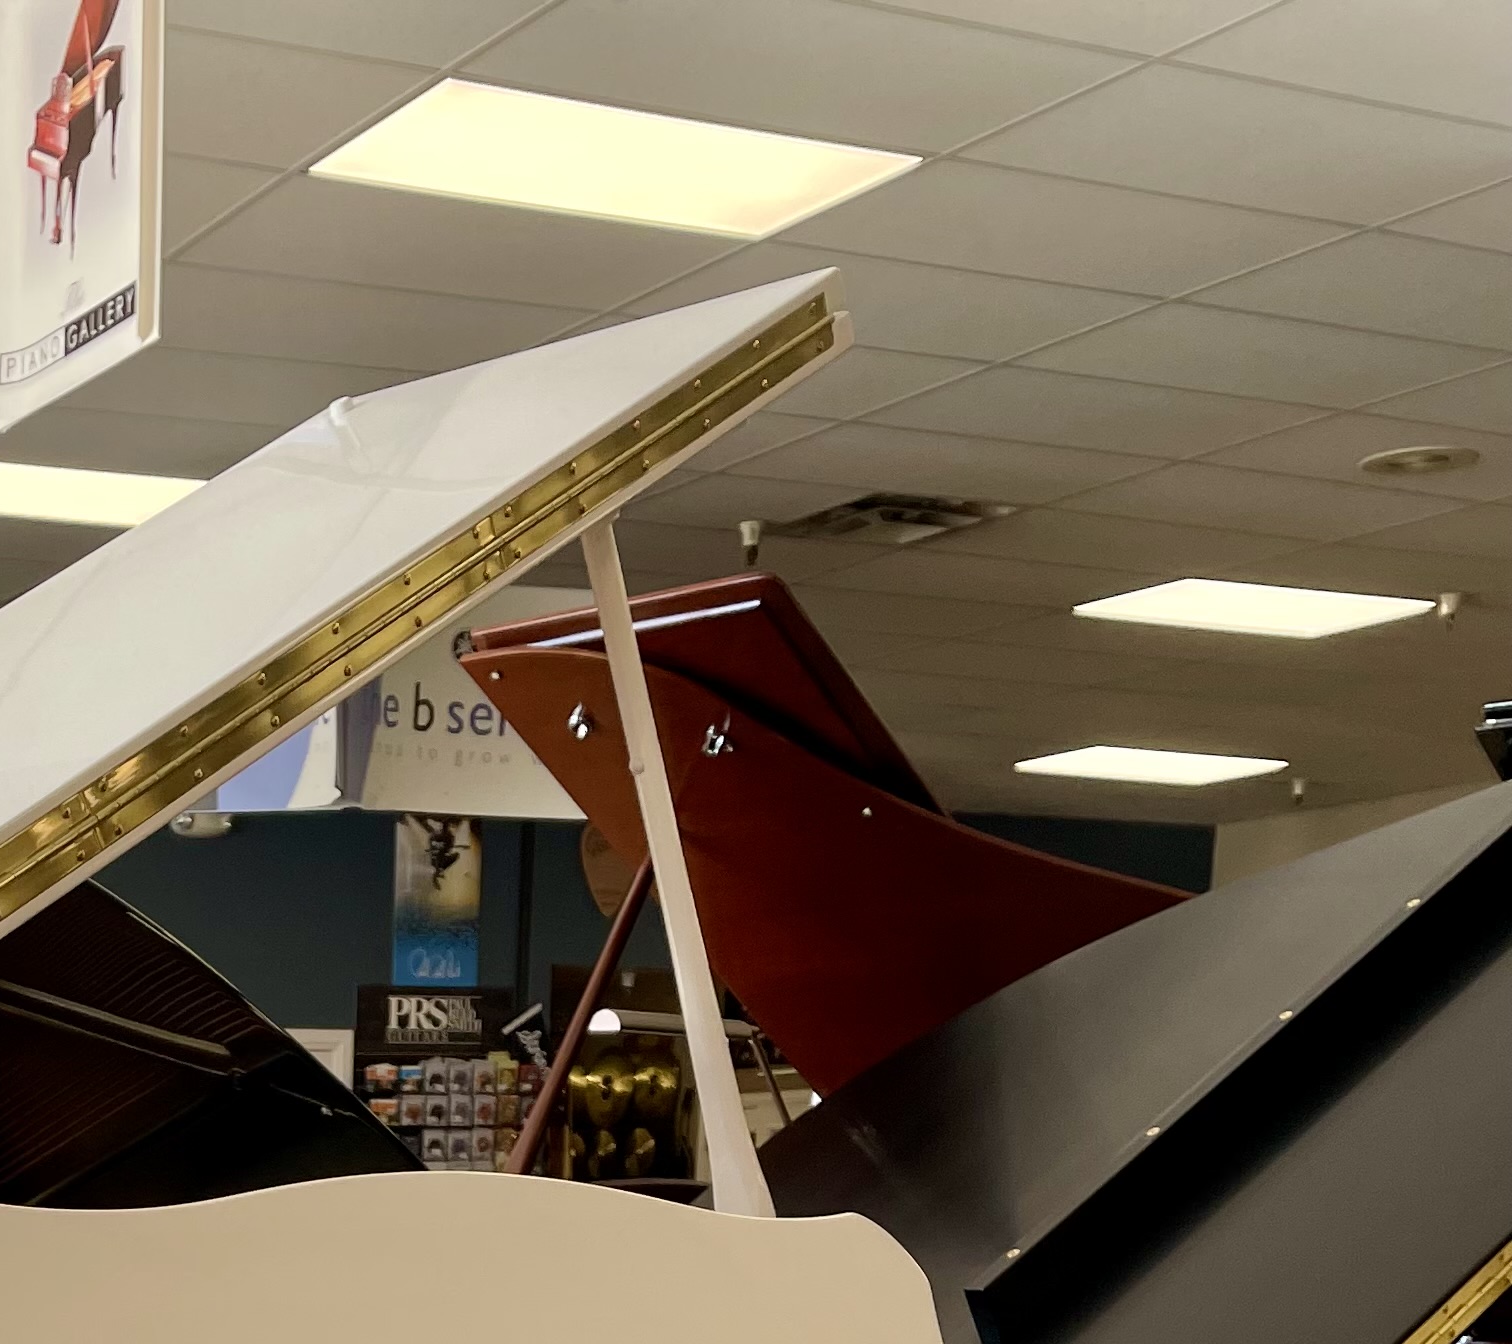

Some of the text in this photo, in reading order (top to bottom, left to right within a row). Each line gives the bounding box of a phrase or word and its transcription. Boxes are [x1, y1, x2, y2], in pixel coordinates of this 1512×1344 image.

[6, 286, 136, 379] PIANO GALLERY
[412, 680, 435, 732] b
[388, 997, 448, 1030] PRS
